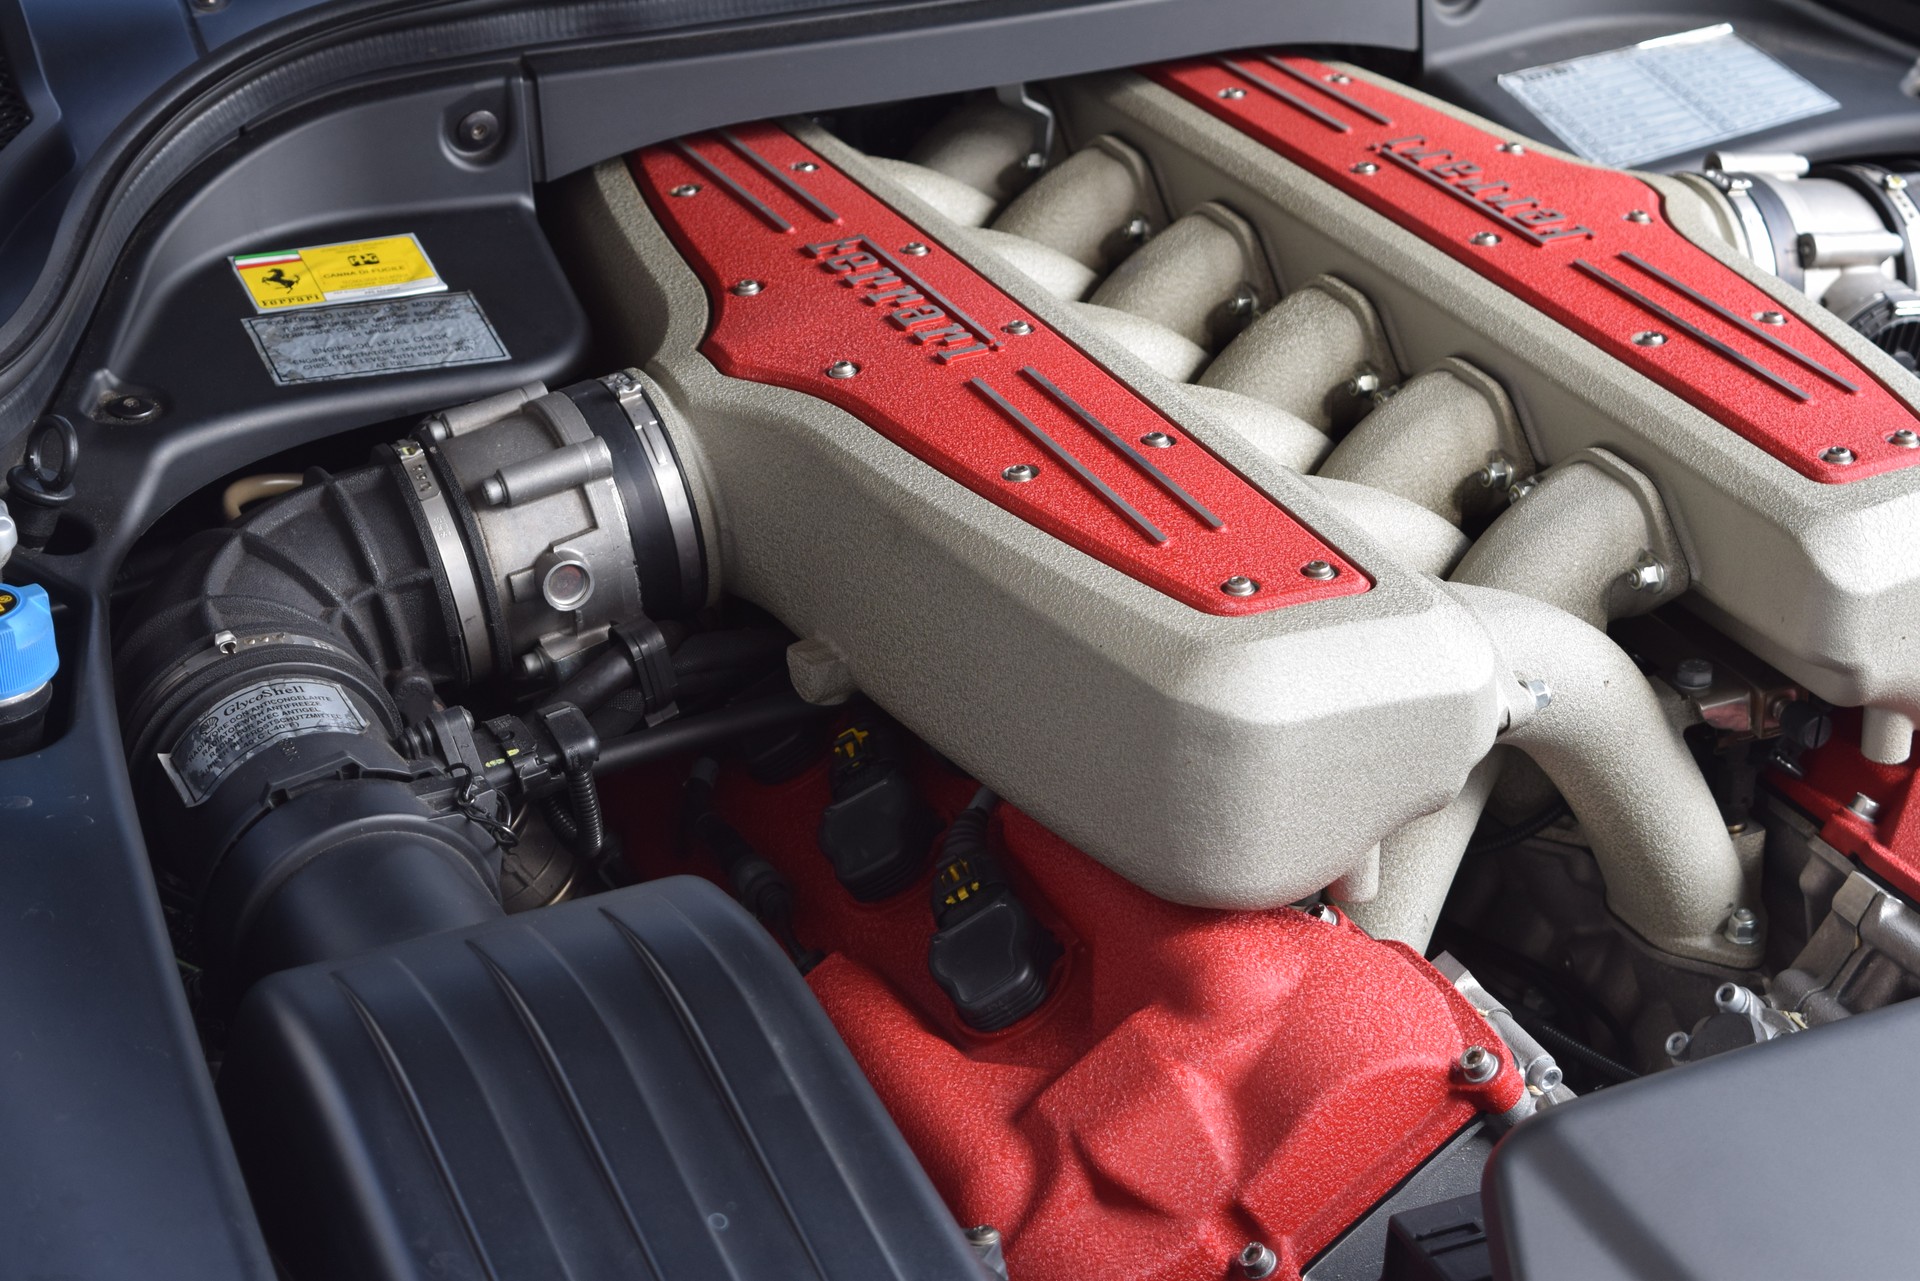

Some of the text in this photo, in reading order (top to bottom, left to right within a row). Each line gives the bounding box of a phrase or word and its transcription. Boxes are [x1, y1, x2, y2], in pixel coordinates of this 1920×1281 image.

[1371, 134, 1595, 243] Ferrari
[323, 270, 357, 279] CANNA
[261, 294, 320, 307] Ferrari
[805, 233, 1004, 362] Ferrari
[337, 308, 379, 318] LIVELLO
[312, 344, 351, 355] ENGINE
[377, 338, 409, 347] LEVEL
[413, 332, 449, 343] CHECK
[291, 356, 327, 366] ENGINE
[303, 361, 335, 370] CHECK
[359, 356, 387, 365] LEVEL
[223, 685, 305, 717] GlycoShell
[229, 710, 250, 724] CON
[251, 694, 333, 713] ANTICONGELANTE
[202, 701, 322, 757] RADIATOR WITH ANTIFREEZE
[209, 706, 322, 759] RADIATEUR AVEC ANTIGEL
[245, 713, 343, 740] FROSTSCHUTZMITTEL
